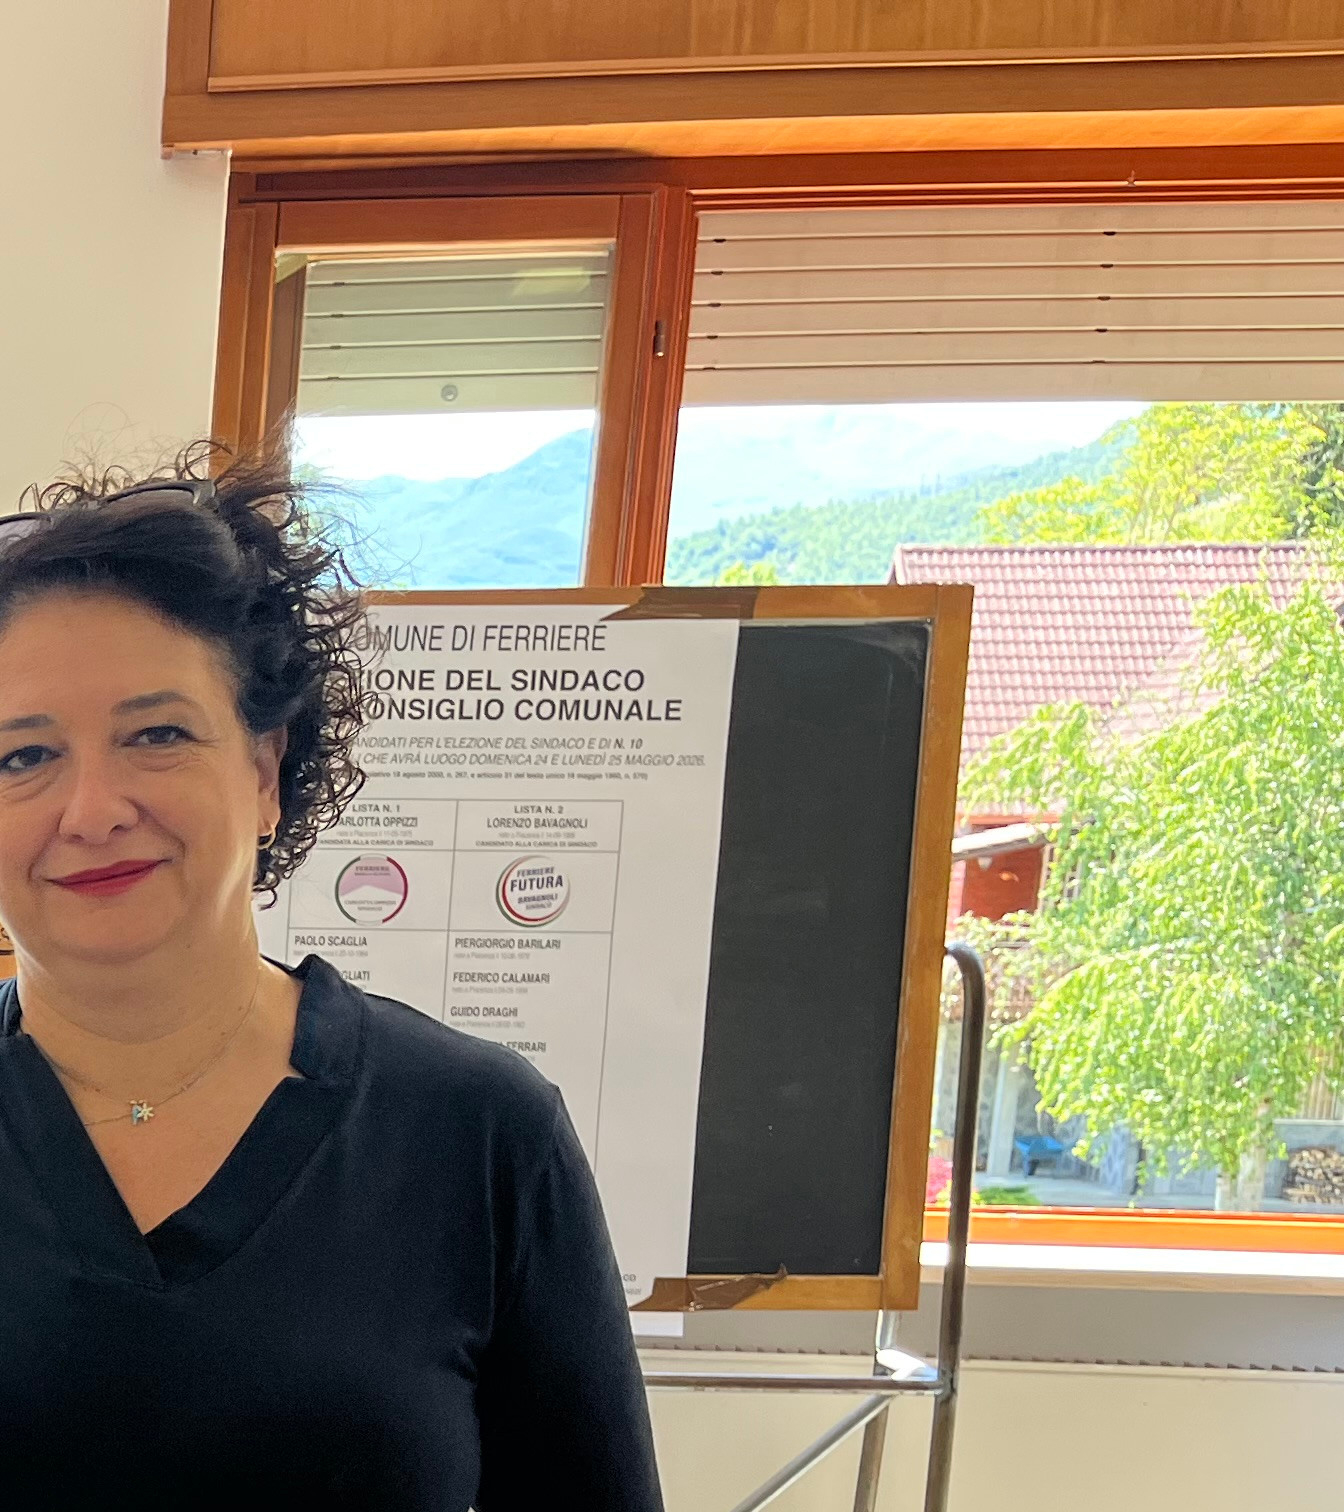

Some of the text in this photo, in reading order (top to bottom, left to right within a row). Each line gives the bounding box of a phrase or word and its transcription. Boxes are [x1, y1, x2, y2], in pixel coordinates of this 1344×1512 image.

[354, 625, 607, 651] OMUNE DI FERRIERE
[362, 669, 644, 691] IONE DEL SINDACO
[365, 698, 682, 721] ONSIGLIO COMUNALE
[353, 737, 407, 749] ANDIDATI
[409, 737, 434, 749] PER
[436, 737, 503, 749] L'ELEZIONE
[504, 737, 527, 749] DEL
[530, 737, 585, 750] SINDACO
[587, 738, 597, 749] E
[598, 738, 612, 749] DI
[630, 738, 643, 749] 10
[363, 753, 389, 765] CHE
[424, 754, 467, 765] LUOGO
[469, 754, 532, 766] DOMENICA
[534, 754, 548, 766] 24
[551, 754, 560, 766] E
[608, 754, 622, 766] 25
[624, 754, 674, 767] MAGGIO
[353, 804, 400, 813] LISTA N. 1
[514, 805, 542, 814] LISTA
[545, 805, 555, 814] N.
[339, 817, 380, 827] ARLOTTA
[487, 817, 588, 829] LORENZO BAVAGNOLI
[510, 875, 564, 892] FUTURA
[294, 935, 368, 947] PAOLO SCAGLIA
[455, 938, 561, 950] PIERGIORGIO BARILARI
[453, 972, 550, 985] FEDERICO CALAMARI
[450, 1006, 518, 1018] GUIDO DRAGHI
